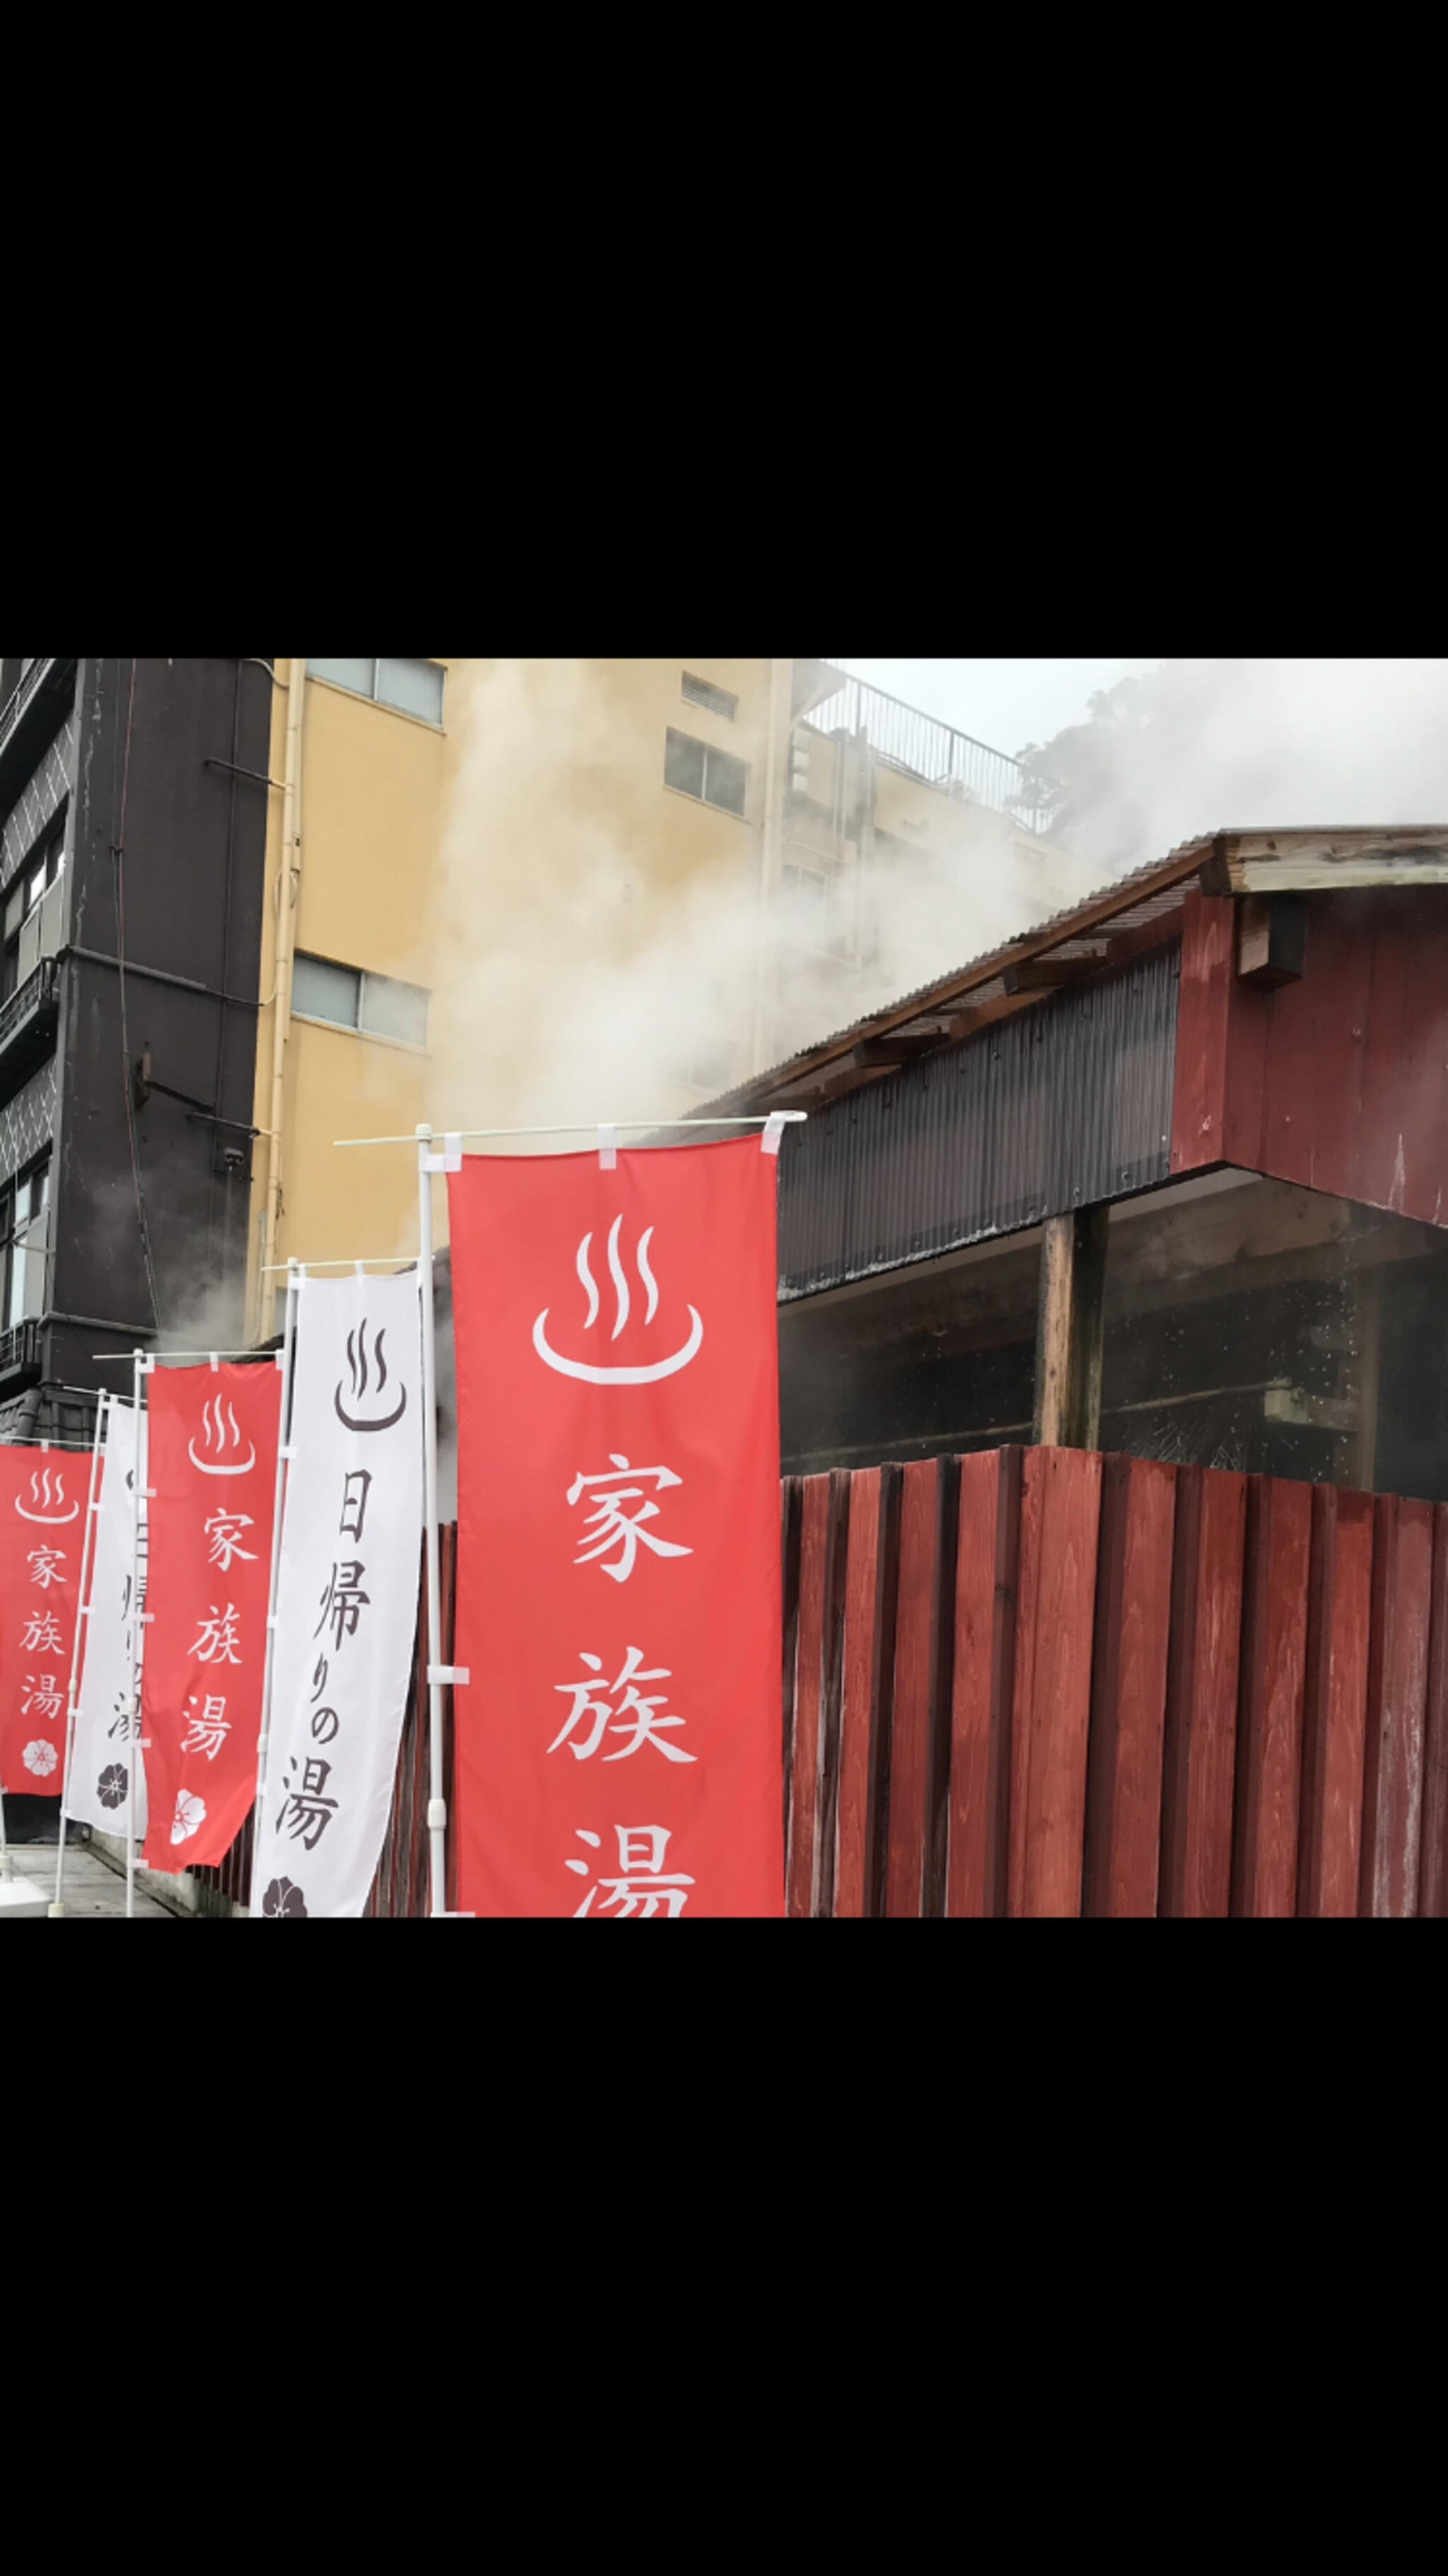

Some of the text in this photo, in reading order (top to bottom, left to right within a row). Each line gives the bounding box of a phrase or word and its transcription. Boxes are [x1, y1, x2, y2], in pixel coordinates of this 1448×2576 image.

[18, 1544, 67, 1720] 家族湯
[180, 1507, 259, 1761] 家族湯
[275, 1469, 372, 1851] 日帰りの湯
[547, 1453, 697, 1918] 家族湯
